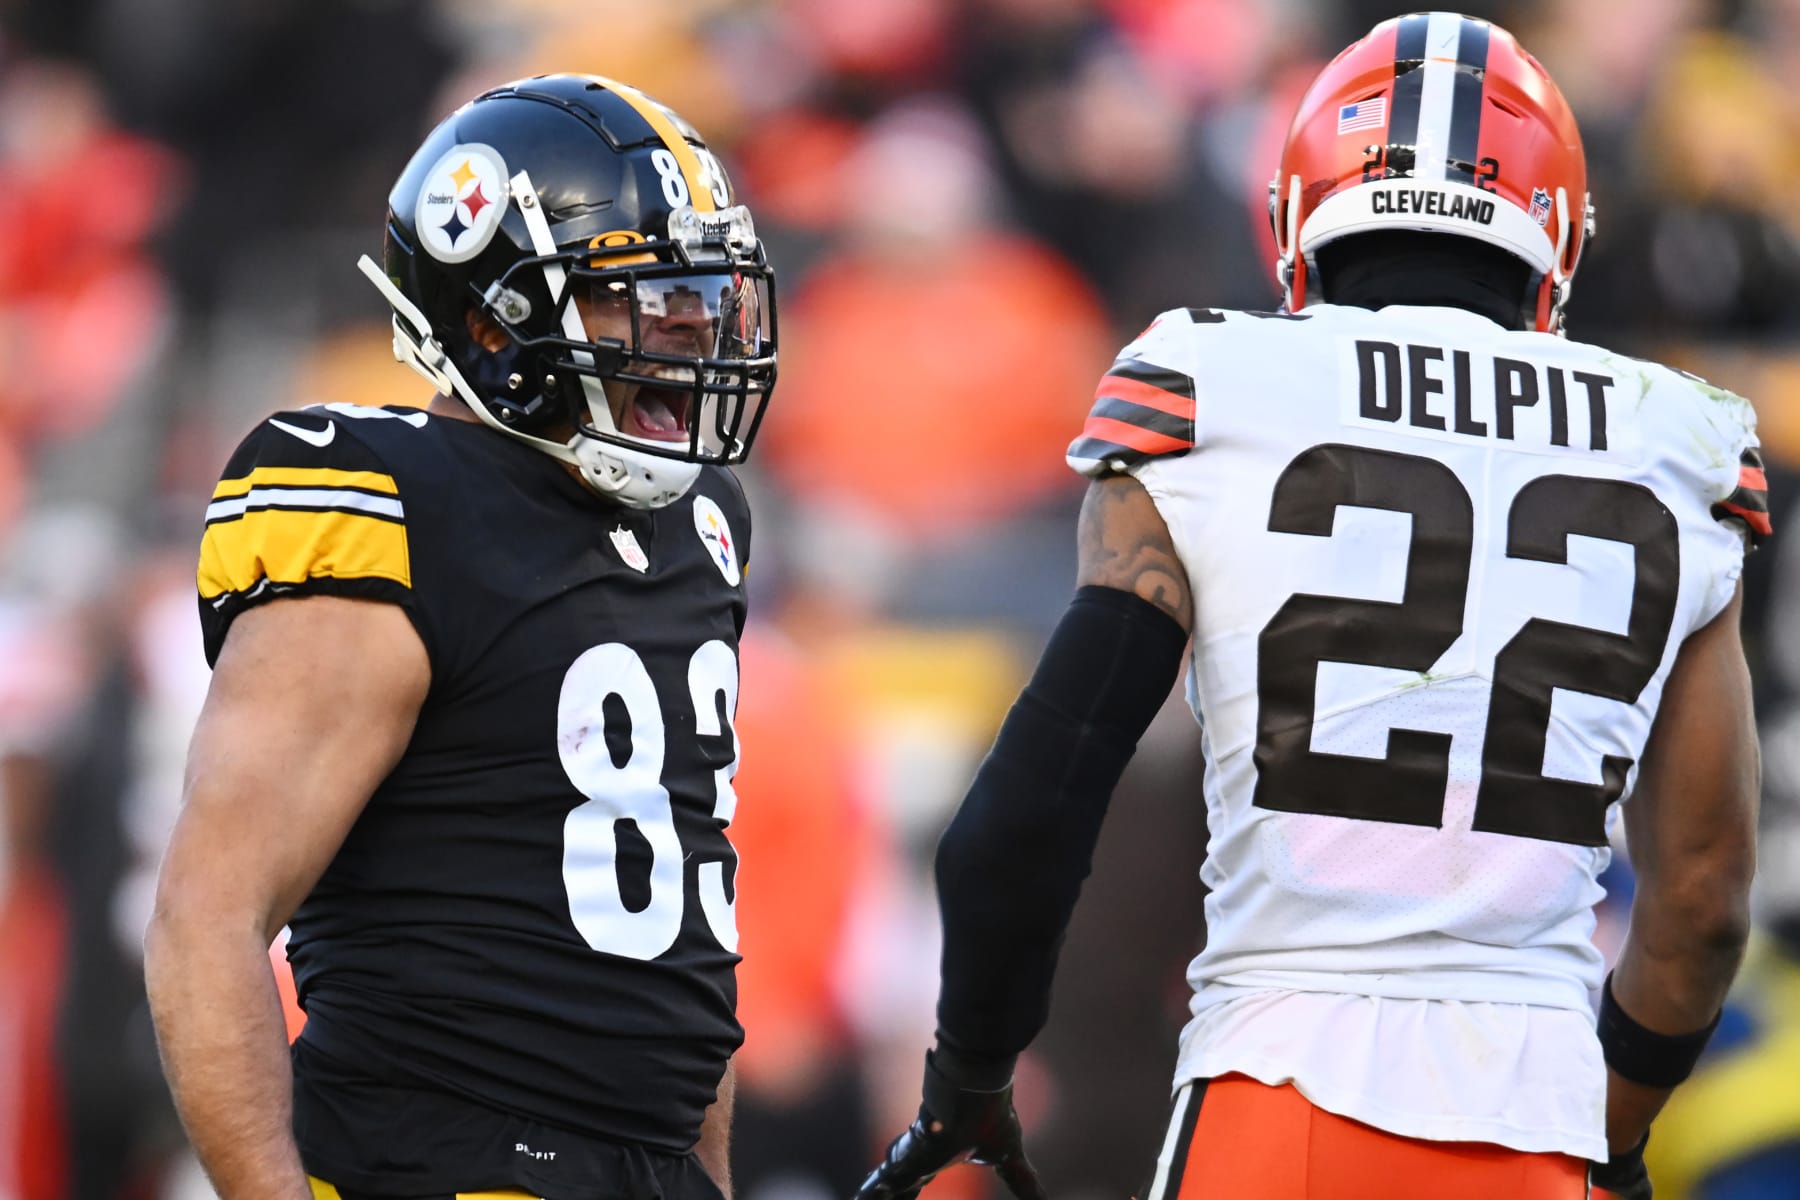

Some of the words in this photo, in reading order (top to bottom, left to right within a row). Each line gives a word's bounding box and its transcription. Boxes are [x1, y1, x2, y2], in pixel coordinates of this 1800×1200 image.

[1372, 190, 1495, 225] CLEVELAND
[1356, 340, 1614, 451] DELPIT
[1253, 443, 1680, 847] 22
[557, 639, 740, 961] 83
